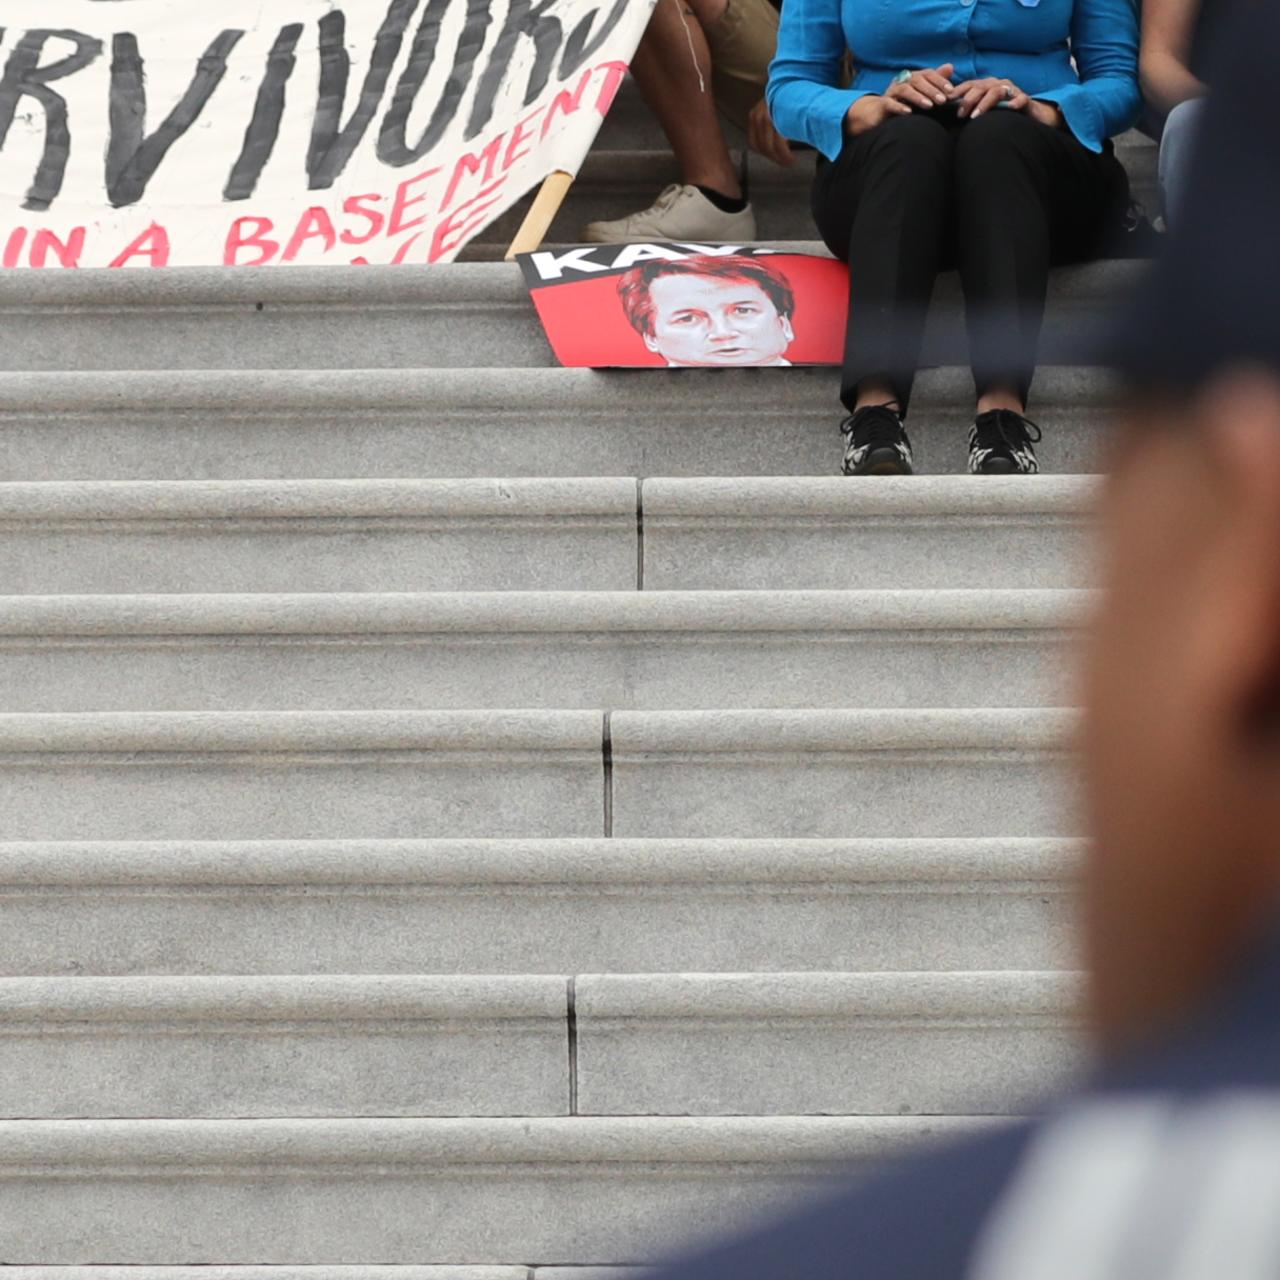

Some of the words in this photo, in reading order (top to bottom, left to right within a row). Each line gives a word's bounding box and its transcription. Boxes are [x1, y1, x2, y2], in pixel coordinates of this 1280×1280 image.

[1, 225, 86, 268] IN
[107, 221, 171, 267] A
[221, 60, 630, 267] BASEMENT
[530, 243, 777, 280] KAV
